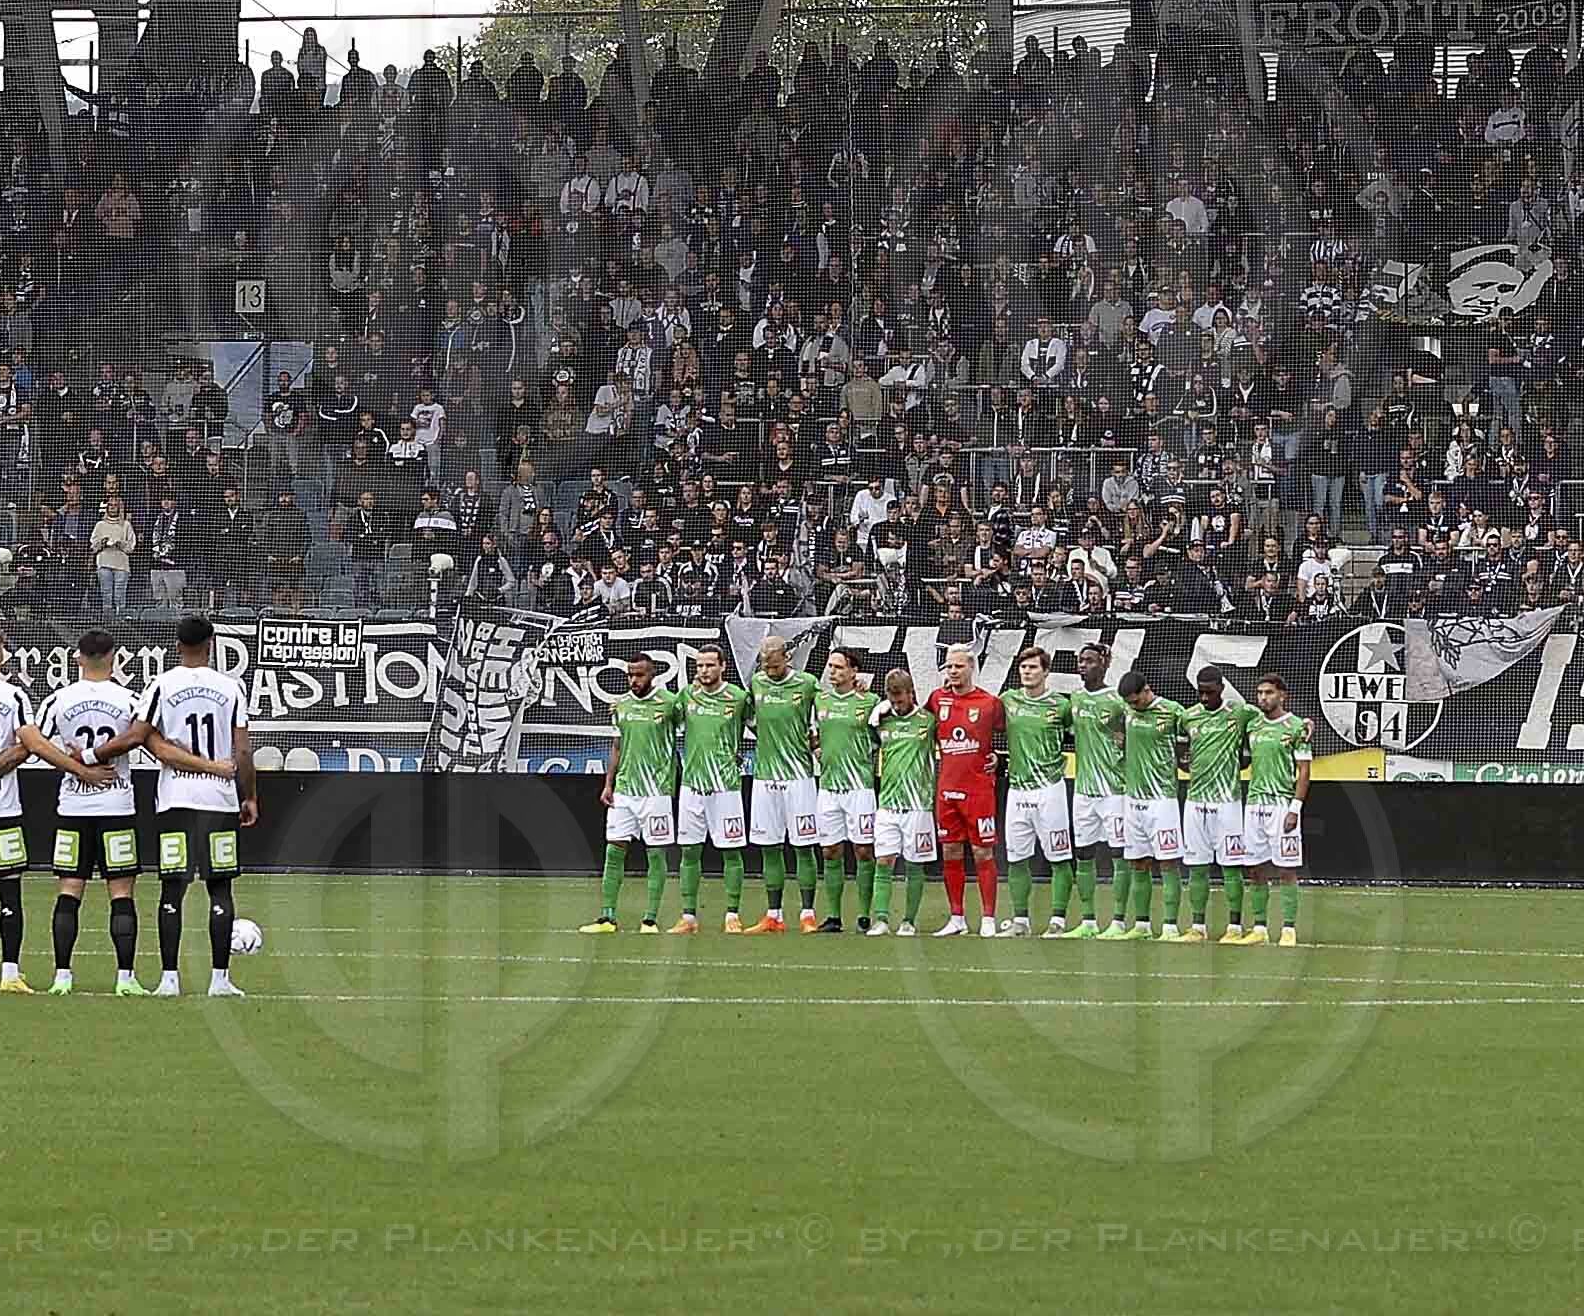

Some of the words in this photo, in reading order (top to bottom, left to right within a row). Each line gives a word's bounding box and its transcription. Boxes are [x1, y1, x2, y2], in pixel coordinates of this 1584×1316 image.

[1495, 0, 1568, 35] 2009
[237, 283, 265, 311] 13
[262, 622, 335, 645] contre
[338, 623, 357, 645] la
[263, 641, 356, 662] répression
[185, 712, 216, 761] 11
